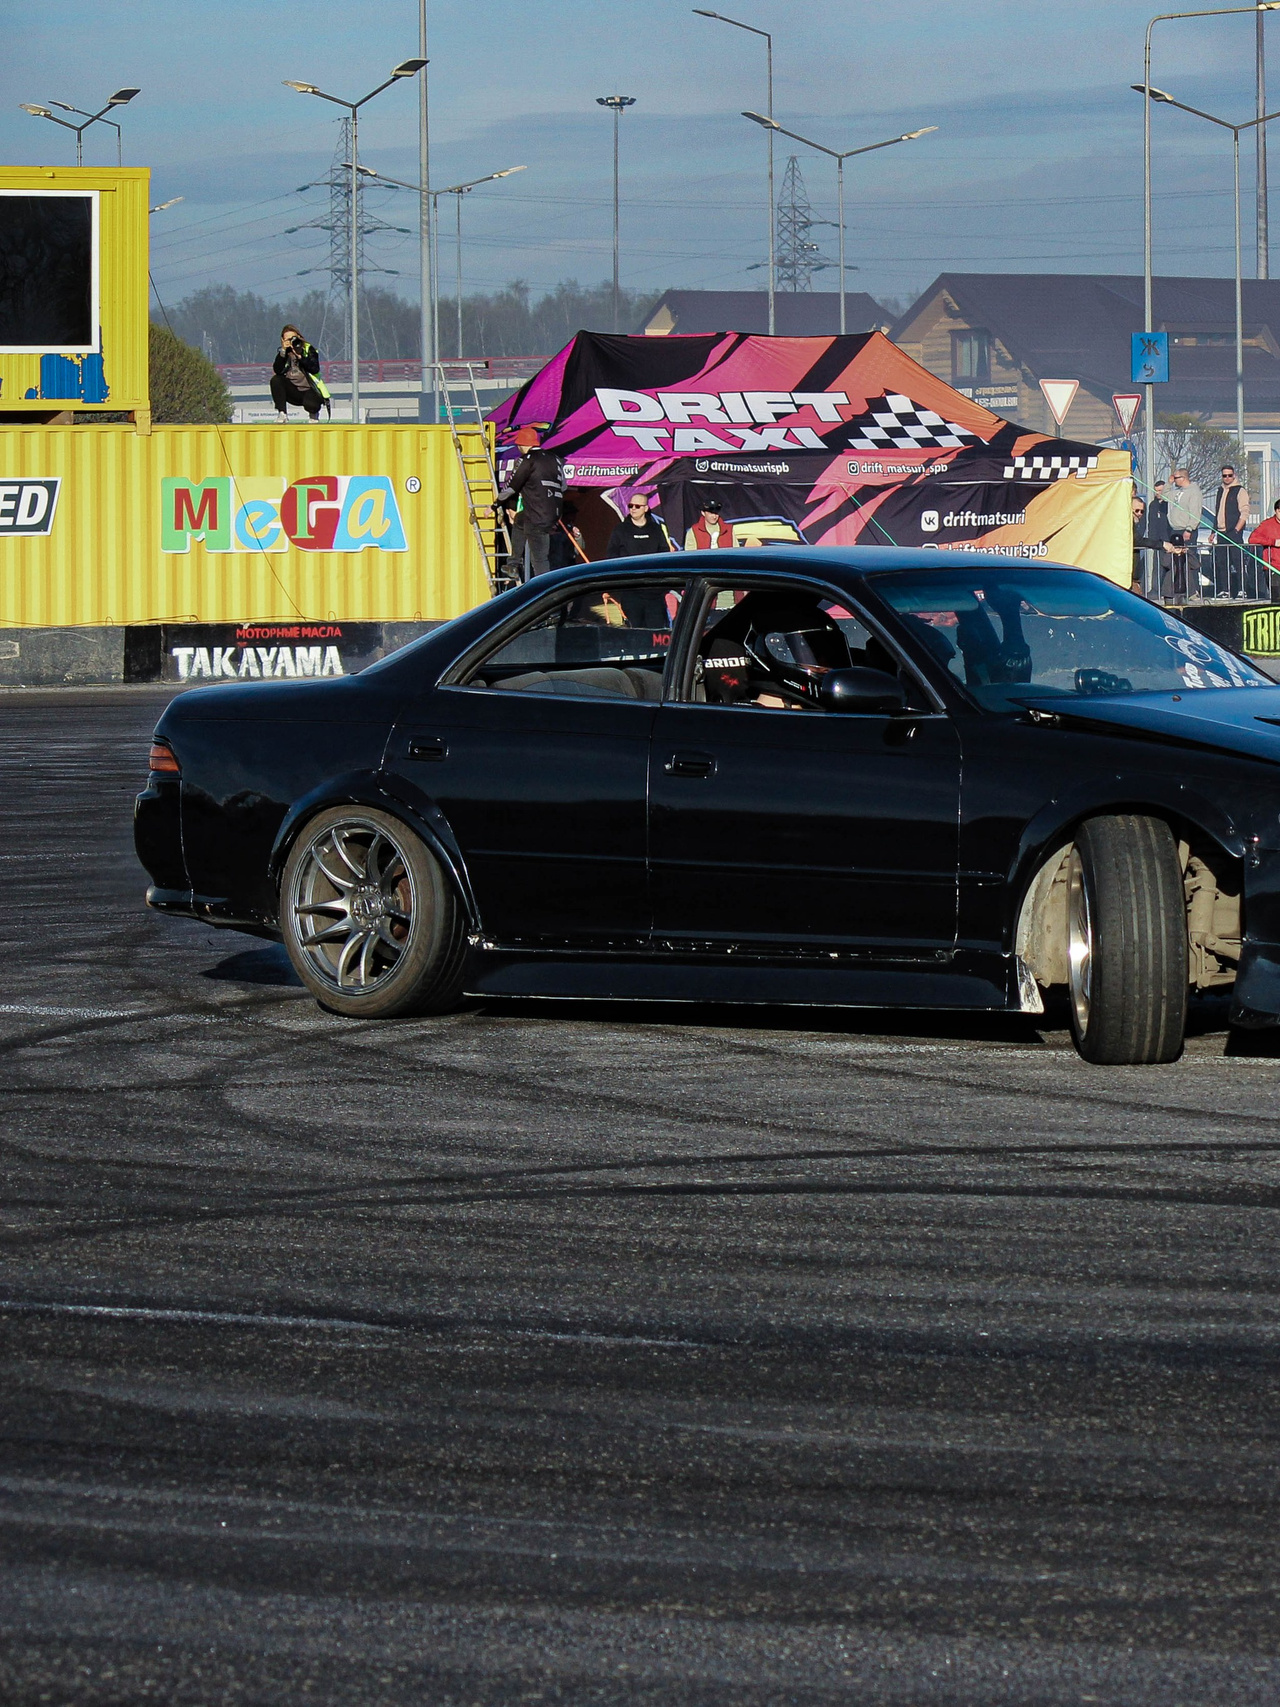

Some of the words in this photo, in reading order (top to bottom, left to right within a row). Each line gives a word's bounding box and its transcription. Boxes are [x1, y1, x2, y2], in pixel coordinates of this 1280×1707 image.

[594, 388, 850, 423] DRIFT
[610, 426, 829, 452] TAXI
[577, 464, 639, 477] driftmatsuri
[943, 509, 1026, 527] driftmatsuri
[236, 626, 300, 640] МОТОРНЫЕ
[301, 626, 342, 638] МАСЛА
[172, 646, 345, 678] TAKAYAMA
